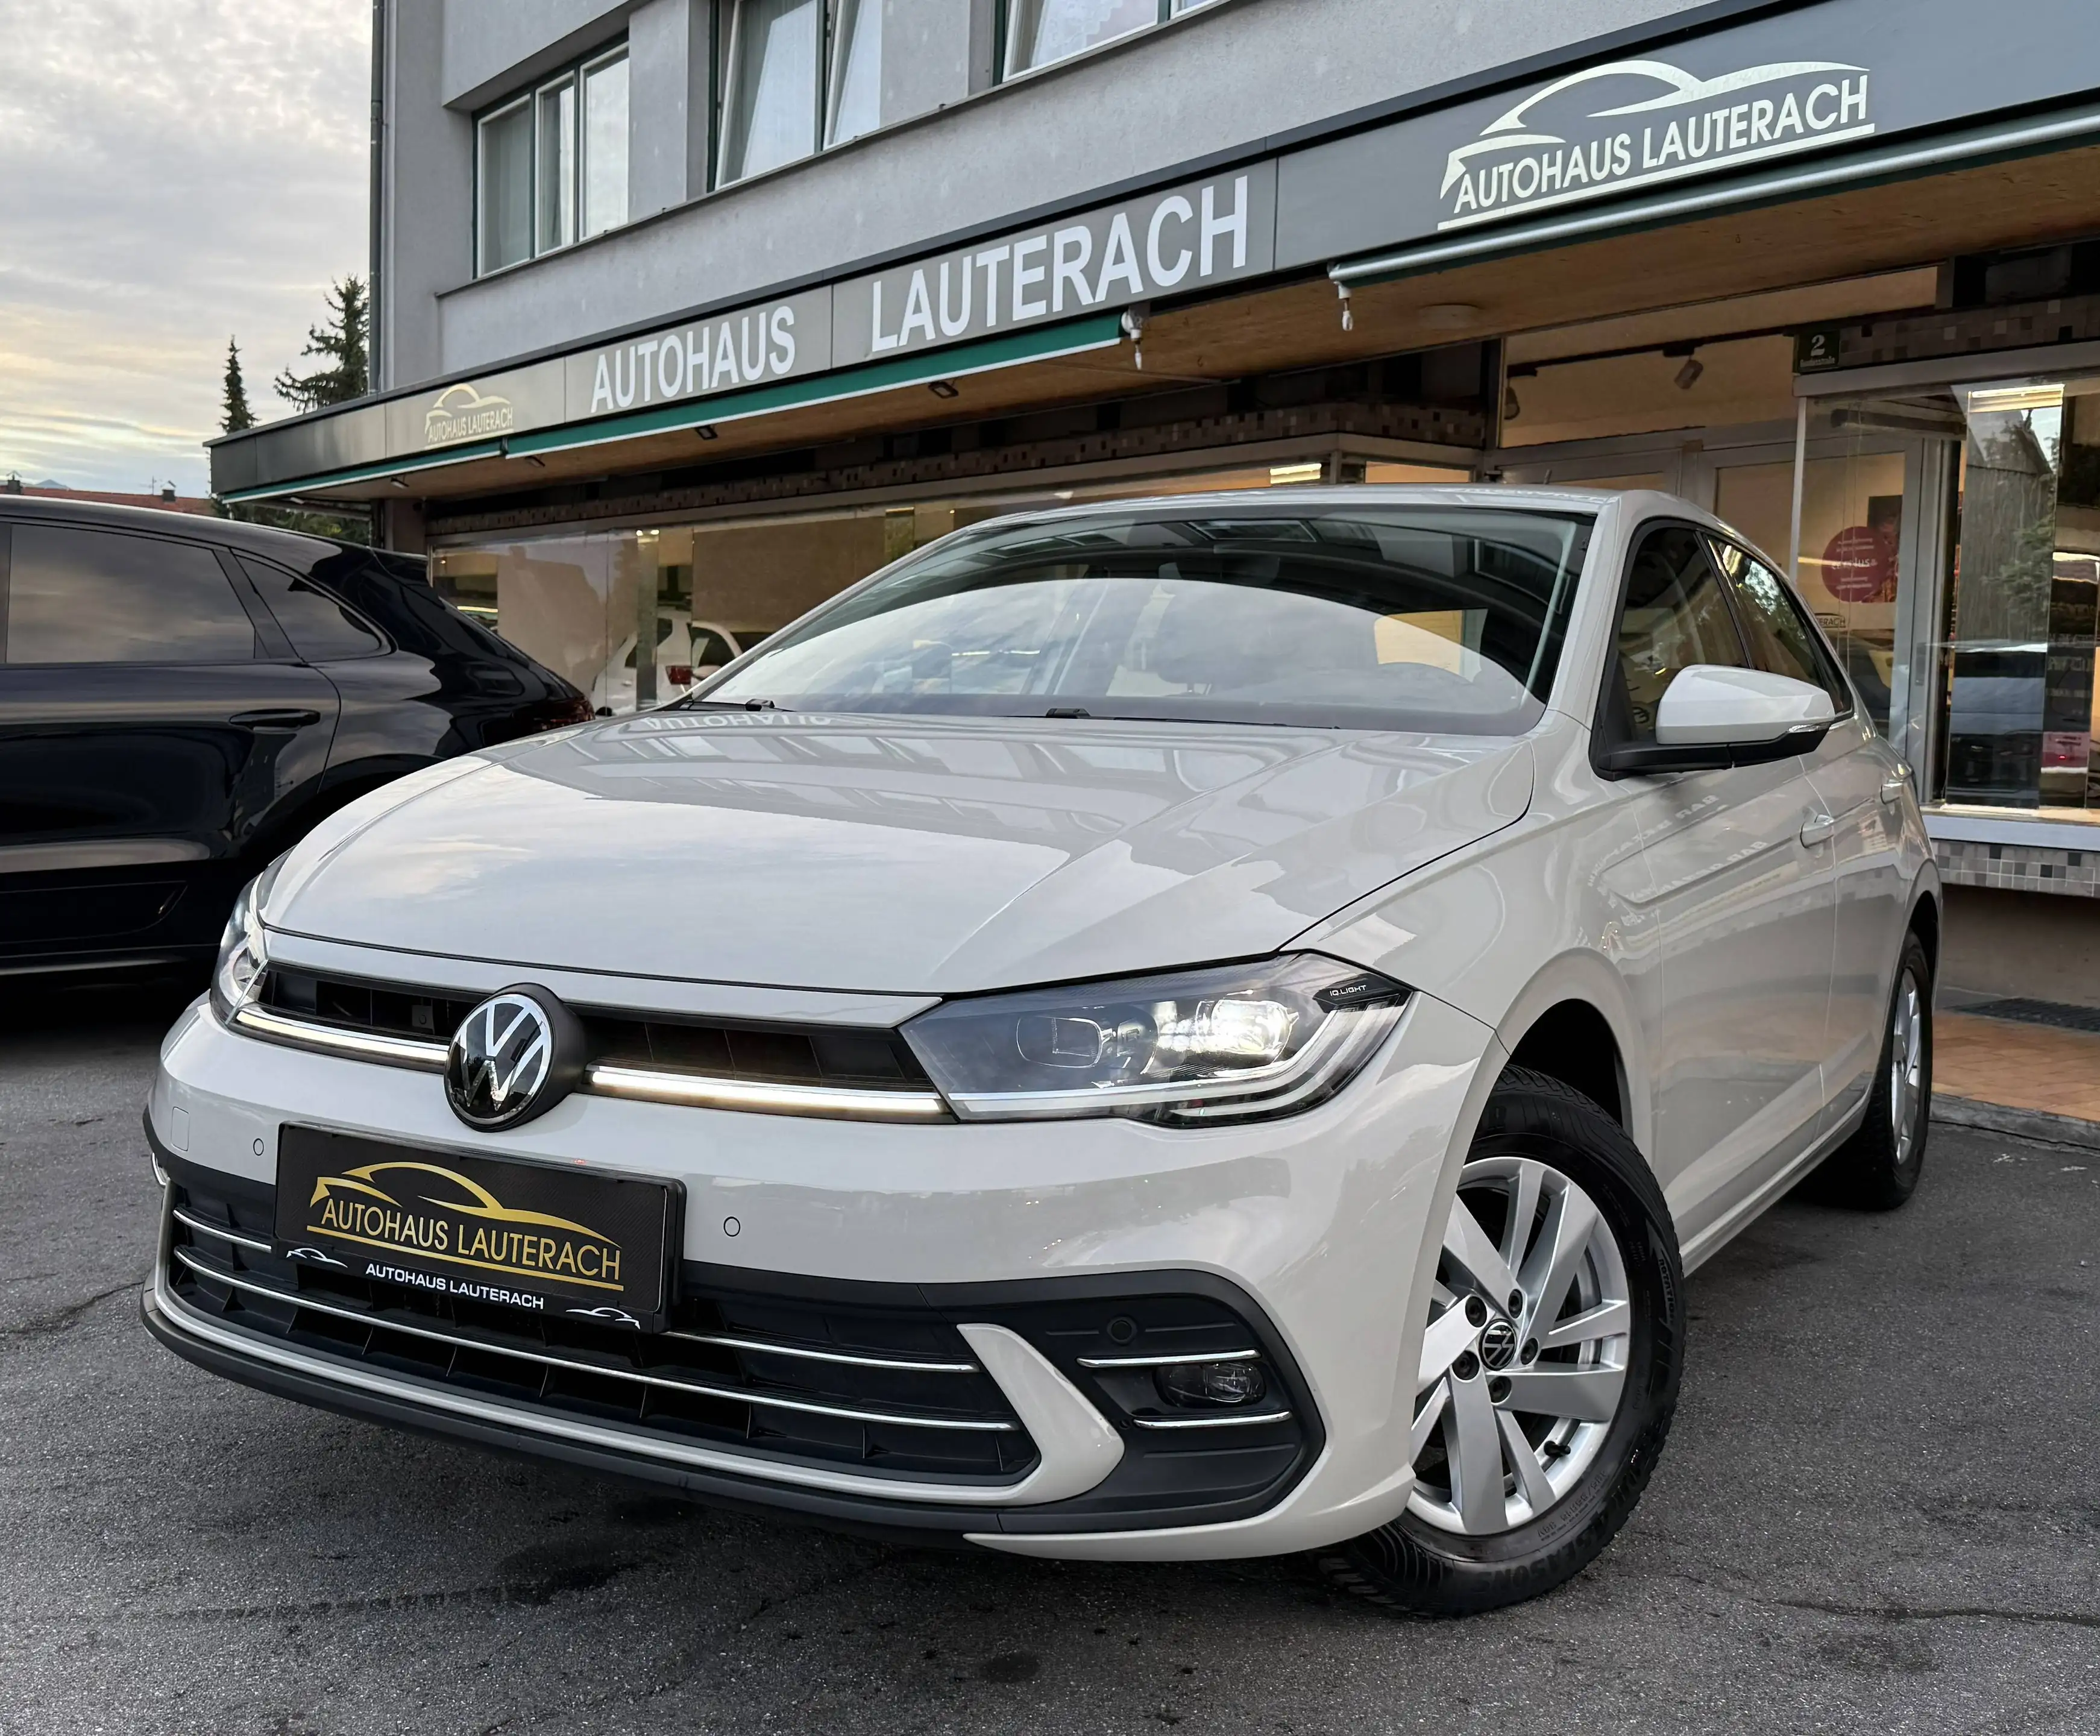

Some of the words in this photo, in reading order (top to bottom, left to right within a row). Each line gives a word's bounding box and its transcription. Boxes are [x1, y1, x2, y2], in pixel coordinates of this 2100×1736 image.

[1454, 134, 1631, 214] AUTOHAUS
[1643, 75, 1869, 169] LAUTERACH
[591, 306, 796, 414] AUTOHAUS
[872, 175, 1248, 351] LAUTERACH
[1811, 335, 1825, 356] 2
[429, 416, 467, 442] AUTOHAUS
[469, 407, 513, 433] LAUTERACH
[1330, 985, 1366, 996] IQ.LIGHT
[322, 1198, 448, 1248] AUTOHAUS
[457, 1224, 620, 1280] LAUTERACH
[366, 1263, 446, 1290] AUTOHAUS
[450, 1280, 544, 1309] LAUTERACH
